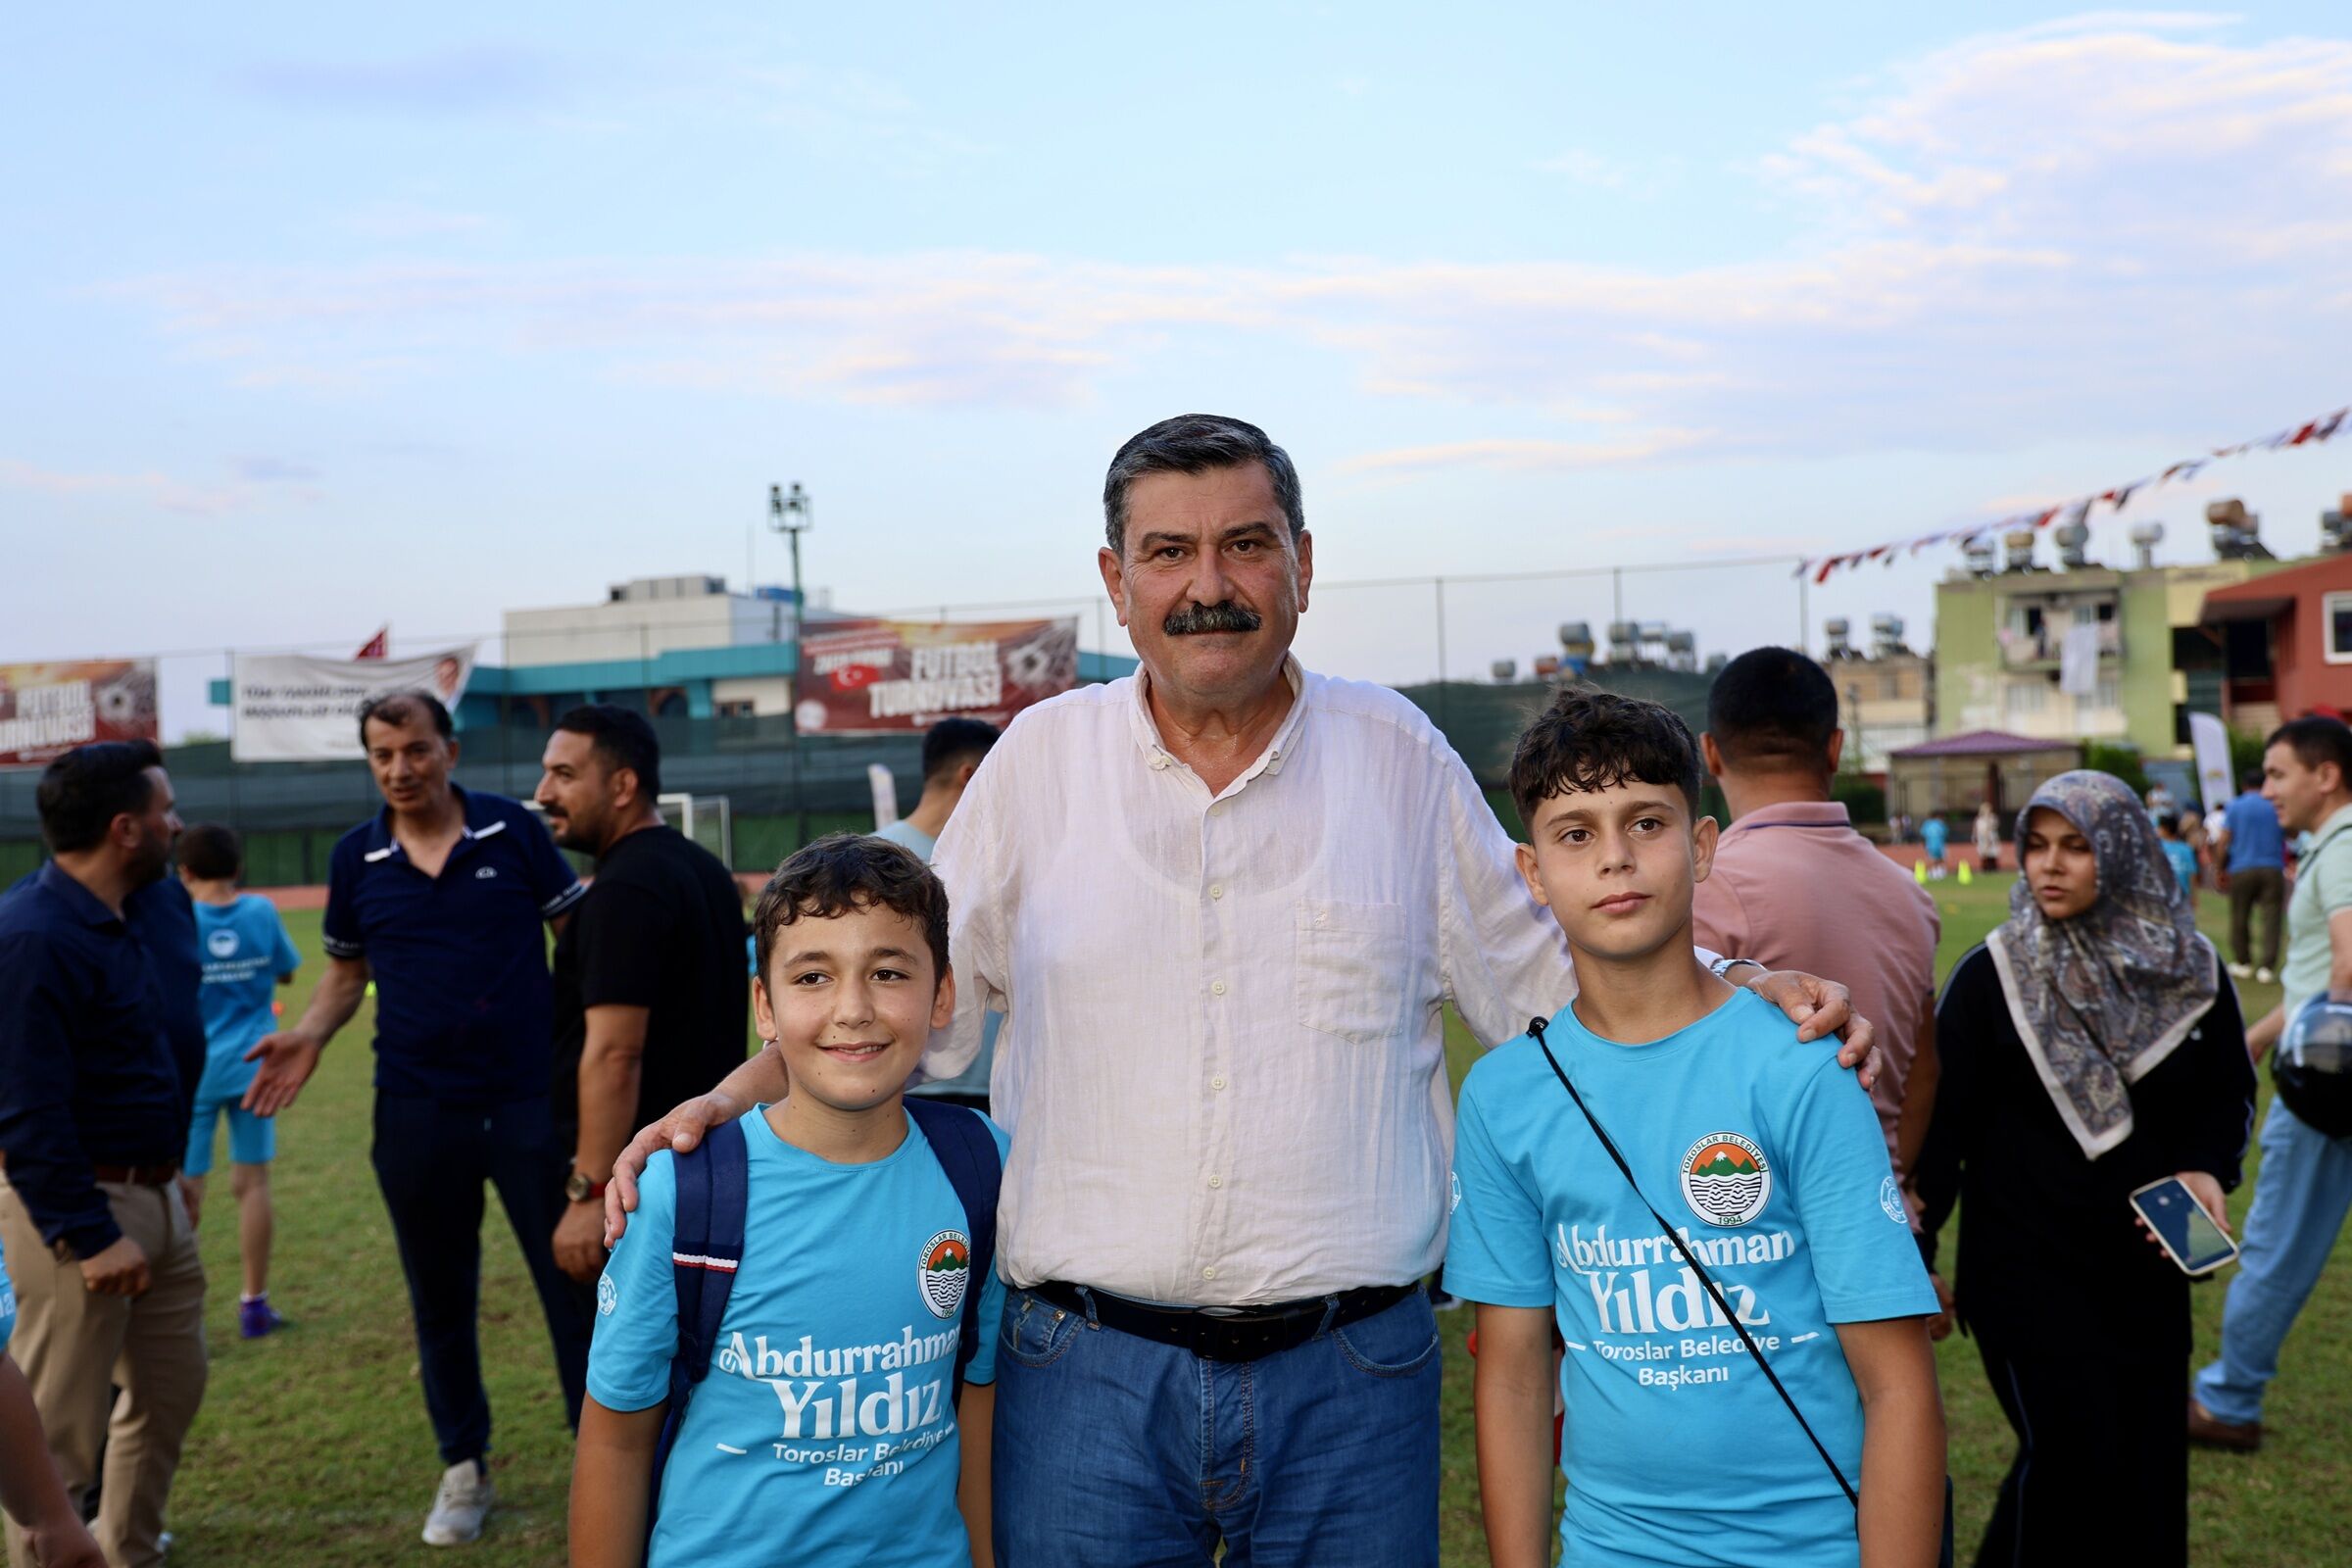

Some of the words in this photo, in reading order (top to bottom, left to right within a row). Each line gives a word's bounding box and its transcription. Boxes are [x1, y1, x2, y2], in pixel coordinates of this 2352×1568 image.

[1683, 1135, 1719, 1174] TOROSLAR
[1718, 1215, 1743, 1225] 1994
[920, 1233, 948, 1270] TOROSLAR
[1593, 1341, 1673, 1361] Toroslar
[1638, 1364, 1729, 1392] Başkanı
[772, 1372, 943, 1440] Yıldız
[772, 1443, 868, 1464] Toroslar
